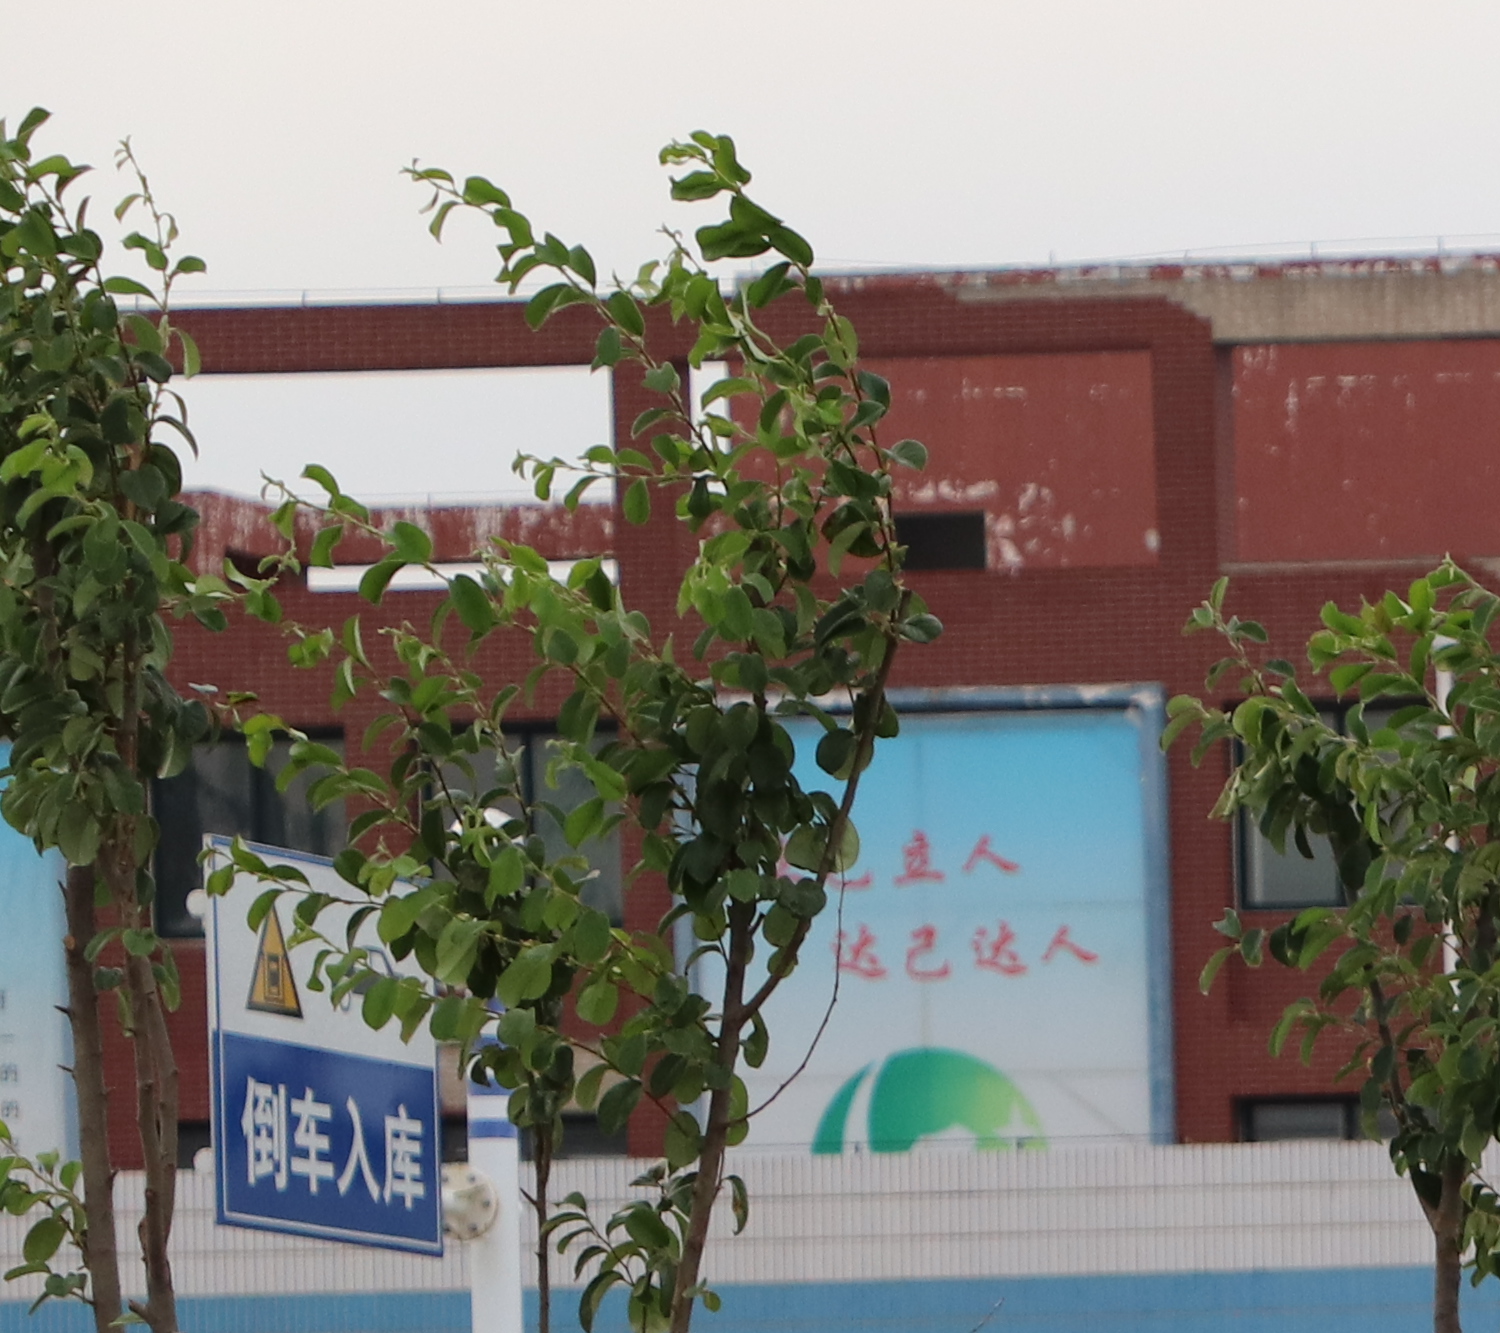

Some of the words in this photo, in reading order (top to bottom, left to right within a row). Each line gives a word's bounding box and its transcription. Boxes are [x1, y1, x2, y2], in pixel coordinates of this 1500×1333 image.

[833, 920, 1099, 979] 达己达人
[240, 1075, 425, 1211] 倒车入库
